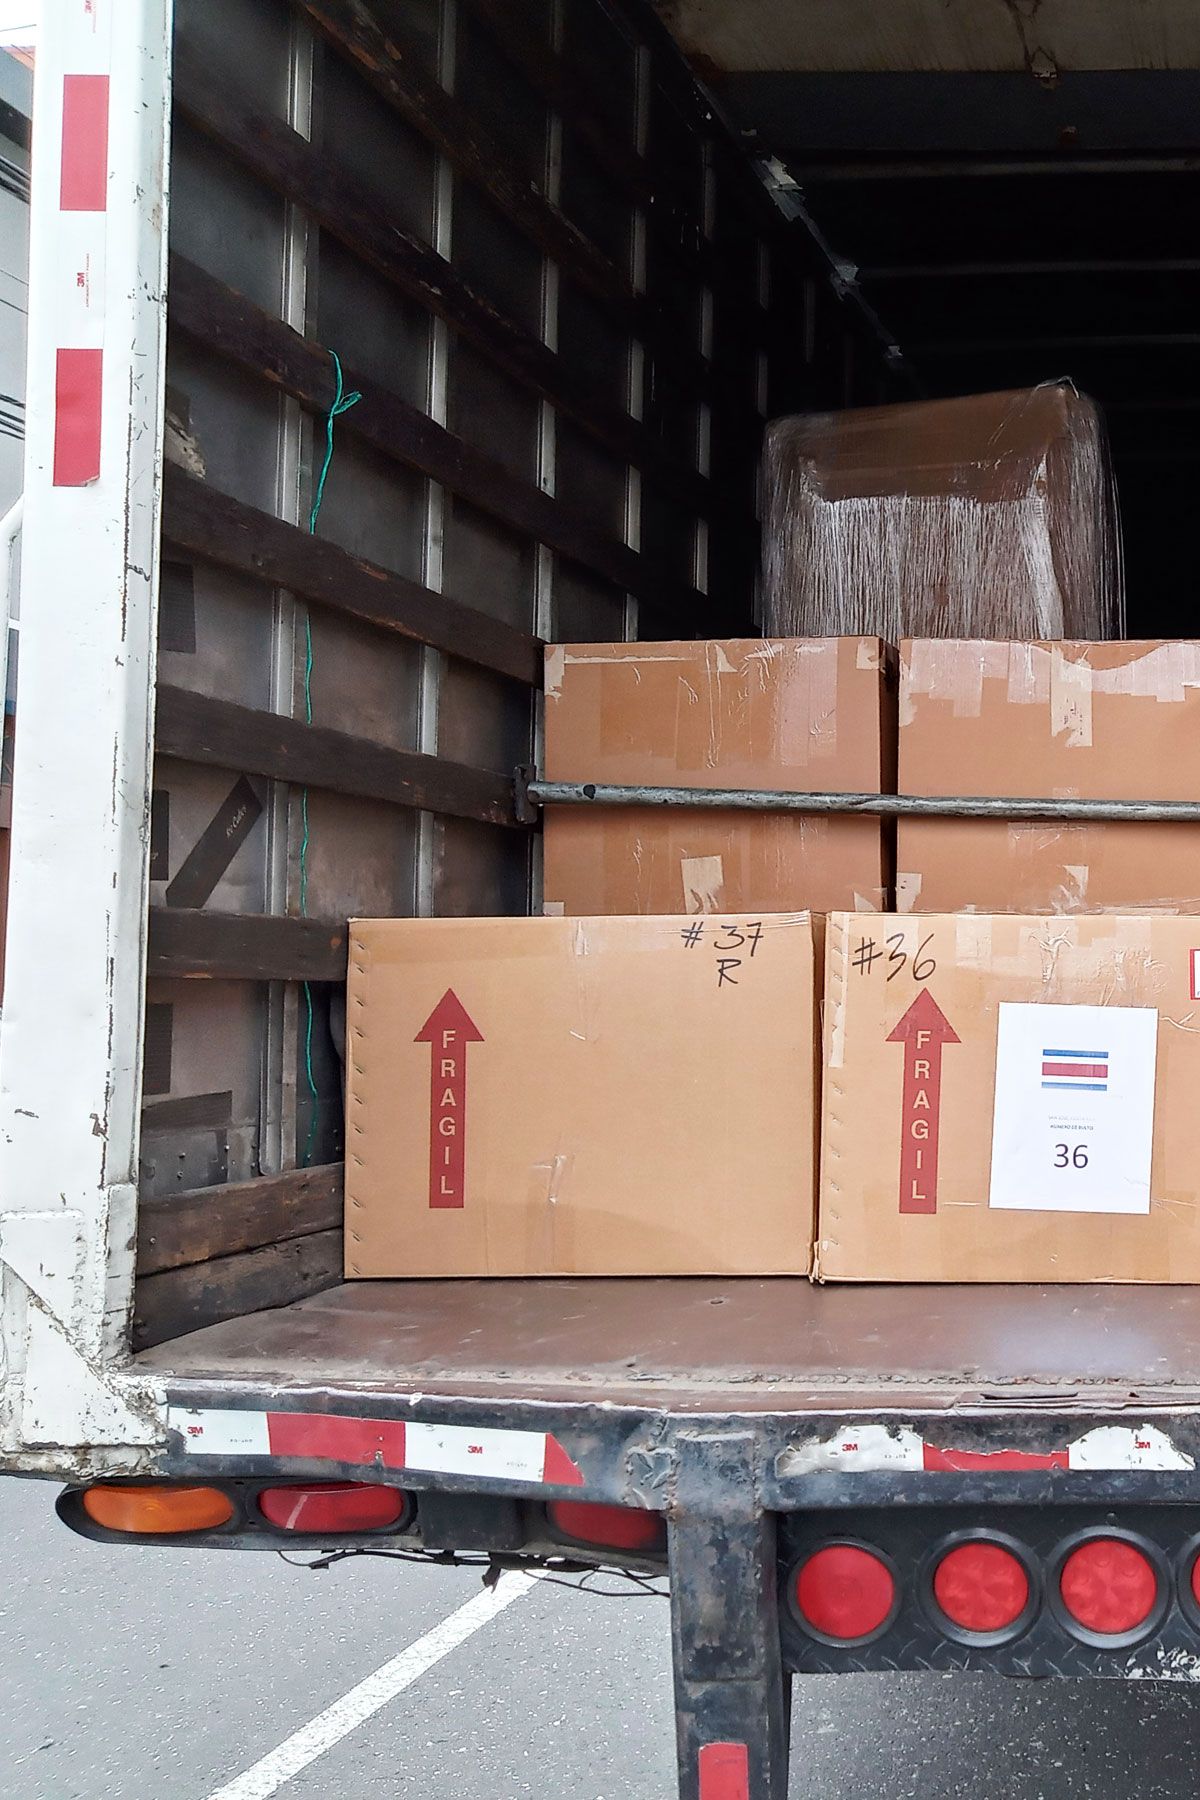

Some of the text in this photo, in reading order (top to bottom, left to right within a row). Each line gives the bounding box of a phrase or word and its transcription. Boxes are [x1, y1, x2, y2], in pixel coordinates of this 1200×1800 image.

[77, 272, 85, 288] 3M
[852, 932, 937, 983] #36
[717, 958, 742, 987] R
[438, 1029, 457, 1195] FRAGIL
[910, 1030, 932, 1200] FRAGIL
[1053, 1143, 1089, 1169] 36
[187, 1426, 204, 1434] 3M
[467, 1445, 483, 1454] 3M
[842, 1443, 858, 1452] 3M
[1134, 1441, 1151, 1449] 3M
